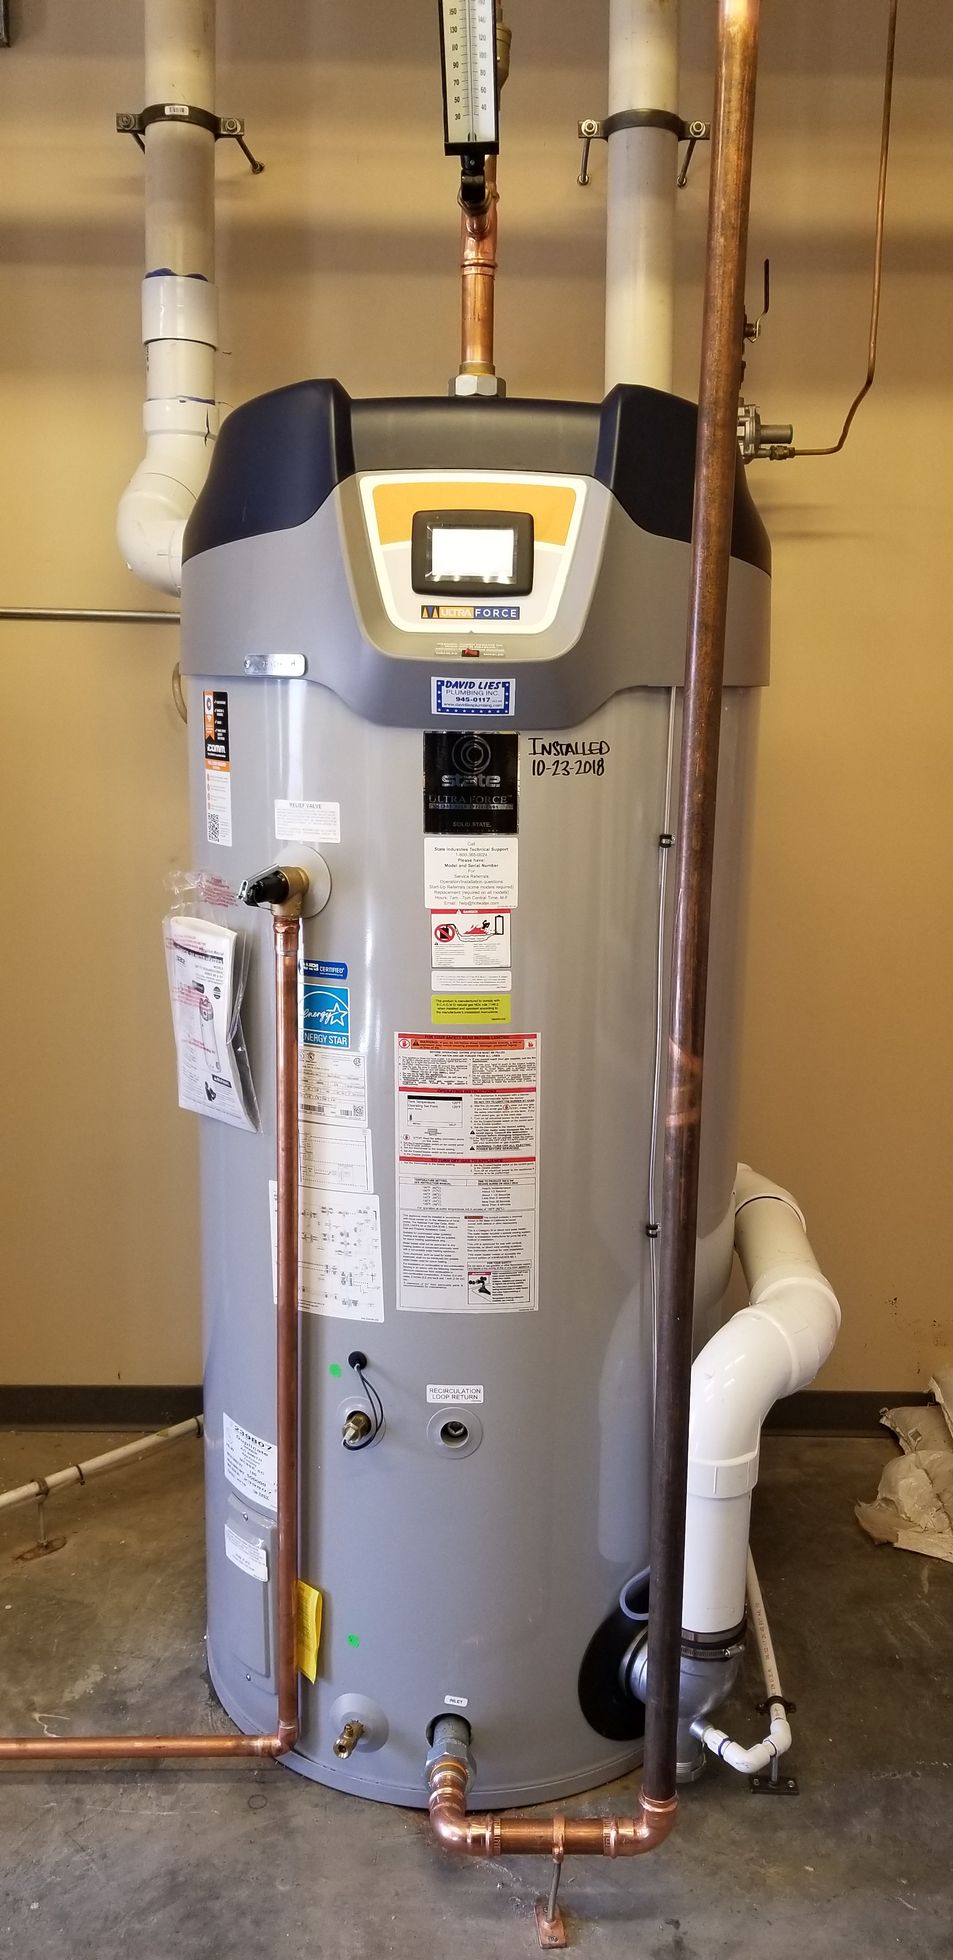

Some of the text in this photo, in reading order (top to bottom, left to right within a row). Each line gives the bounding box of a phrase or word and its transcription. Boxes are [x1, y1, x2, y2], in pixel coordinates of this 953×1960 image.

[440, 608, 516, 617] ULTRA FORCE
[445, 680, 475, 689] DAVID
[528, 738, 610, 756] INSTALLED
[532, 758, 604, 776] 10-23-2018
[442, 774, 500, 787] state
[303, 1033, 347, 1045] NERGY STAR
